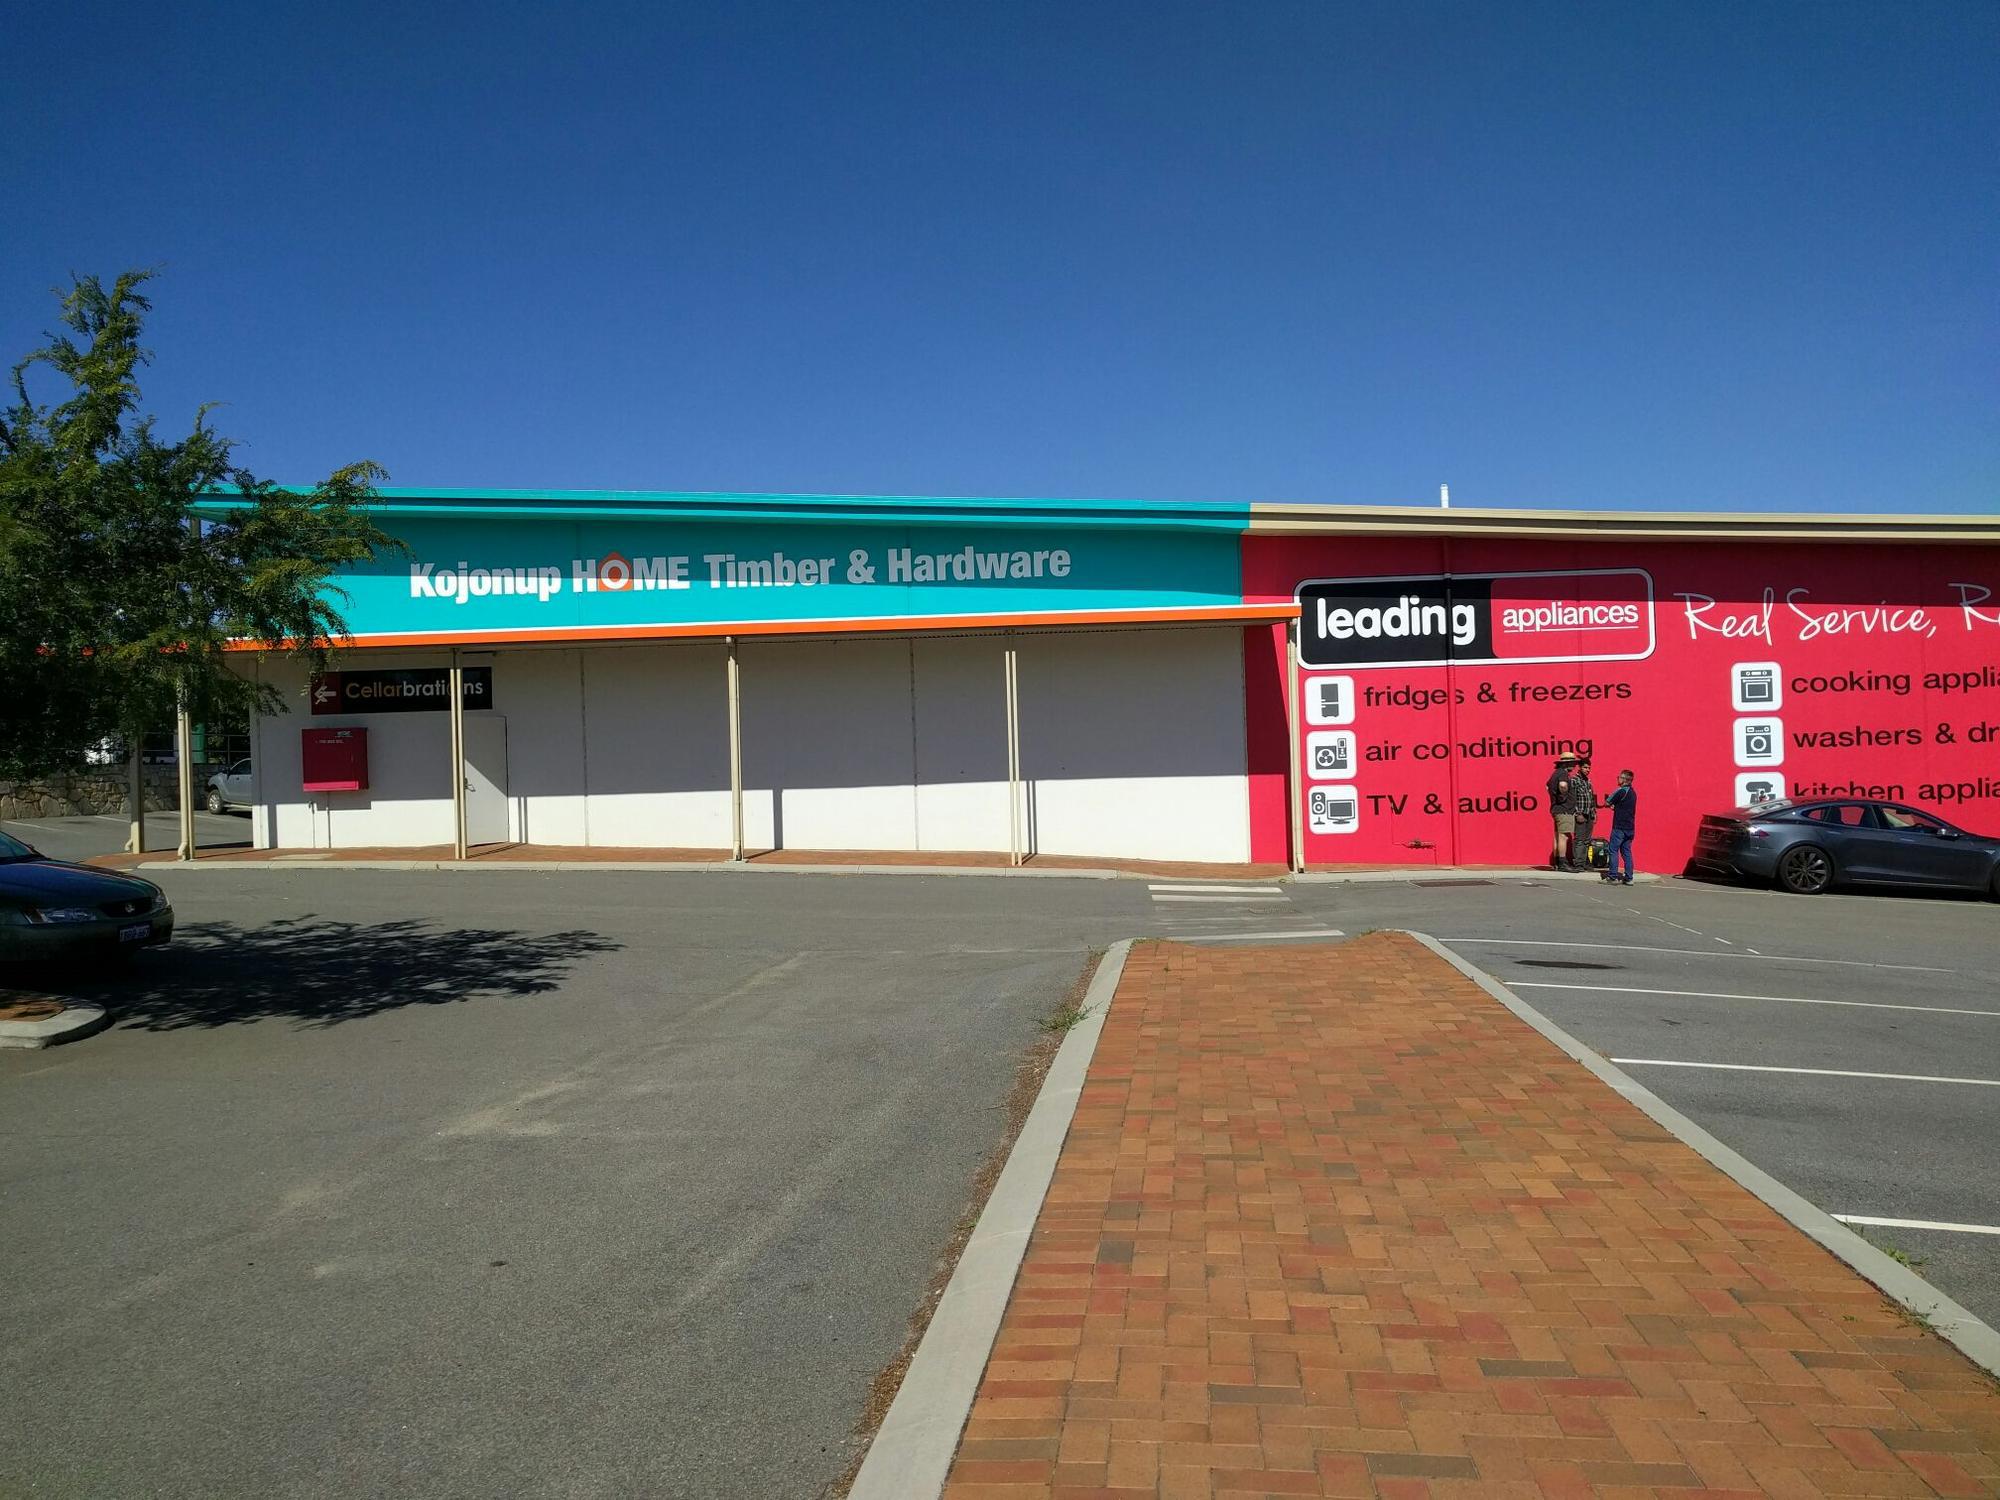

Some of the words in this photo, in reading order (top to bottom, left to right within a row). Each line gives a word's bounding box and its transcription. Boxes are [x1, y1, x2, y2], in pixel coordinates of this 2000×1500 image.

[410, 561, 562, 604] Kojonup
[572, 553, 690, 593] HOME
[703, 552, 836, 589] Timber
[846, 549, 876, 584] &
[887, 545, 1072, 583] Hardware
[1316, 595, 1476, 646] leading
[1502, 602, 1639, 632] appliances
[1673, 586, 1775, 646] Real
[1787, 587, 1937, 641] Service,
[1948, 582, 2000, 631] R
[345, 680, 484, 699] Cellarbratins
[1363, 685, 1465, 710] fridges
[1477, 682, 1498, 703] &
[1508, 681, 1632, 702] freezers
[1791, 670, 1911, 696] cooking
[1923, 666, 2000, 694] appli
[1793, 726, 1922, 748] washers
[1935, 722, 1957, 744] &
[1365, 740, 1402, 761] air
[1366, 794, 1408, 815] TV
[1423, 793, 1444, 814] &
[1458, 791, 1538, 813] audio
